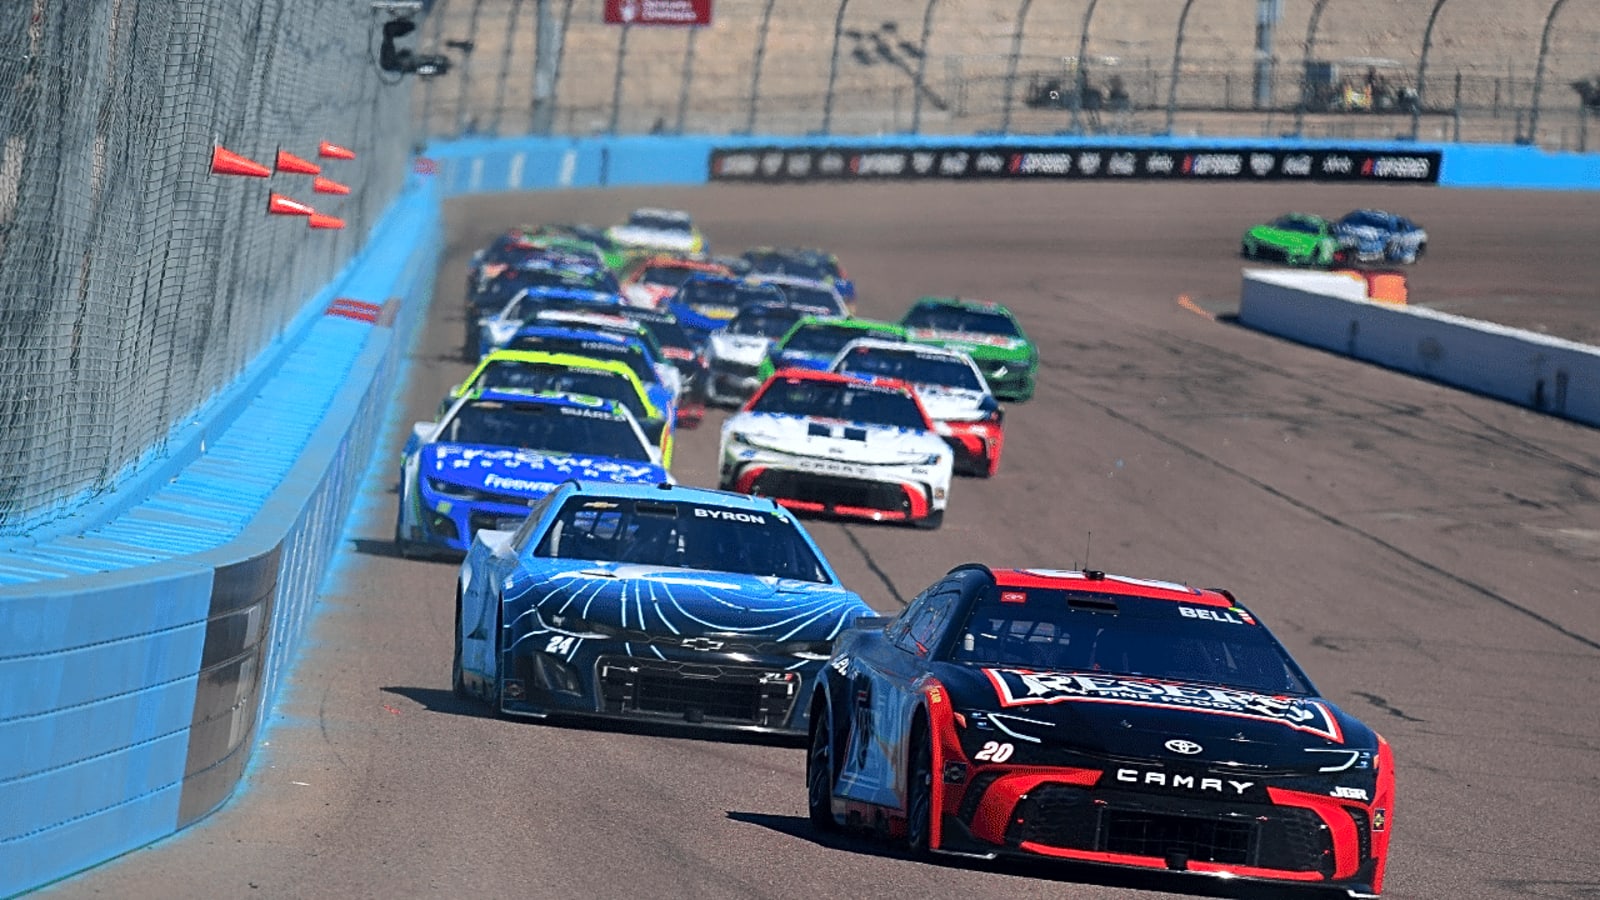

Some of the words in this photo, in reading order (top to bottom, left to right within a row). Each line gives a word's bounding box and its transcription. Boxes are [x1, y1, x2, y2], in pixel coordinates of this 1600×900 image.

[484, 473, 560, 493] Freewa
[694, 507, 766, 525] BYRON
[1178, 606, 1244, 625] BELL
[544, 635, 576, 655] 24
[974, 740, 1015, 764] 20
[1116, 768, 1255, 795] CAMRY
